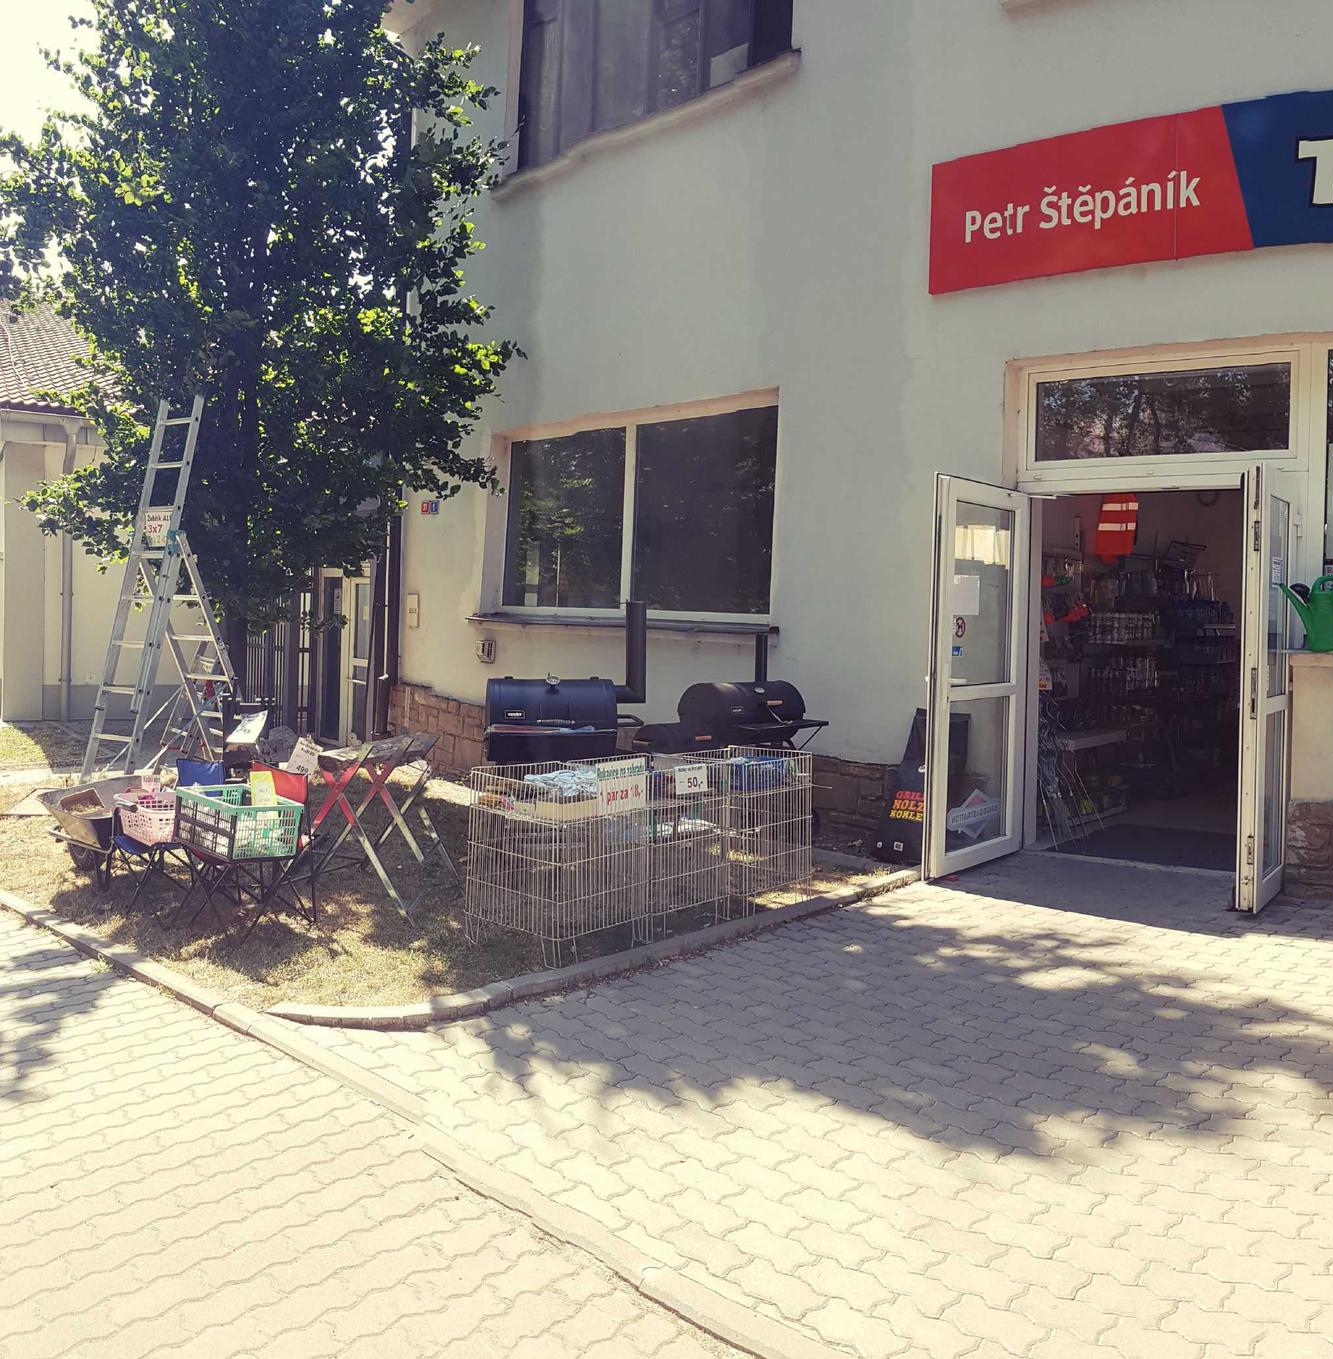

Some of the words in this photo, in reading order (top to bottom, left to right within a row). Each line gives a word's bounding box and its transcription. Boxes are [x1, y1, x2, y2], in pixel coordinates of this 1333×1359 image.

[964, 203, 1029, 243] Petr
[1039, 170, 1200, 230] Štěpáník
[620, 789, 628, 800] za
[889, 809, 923, 821] KOHLE
